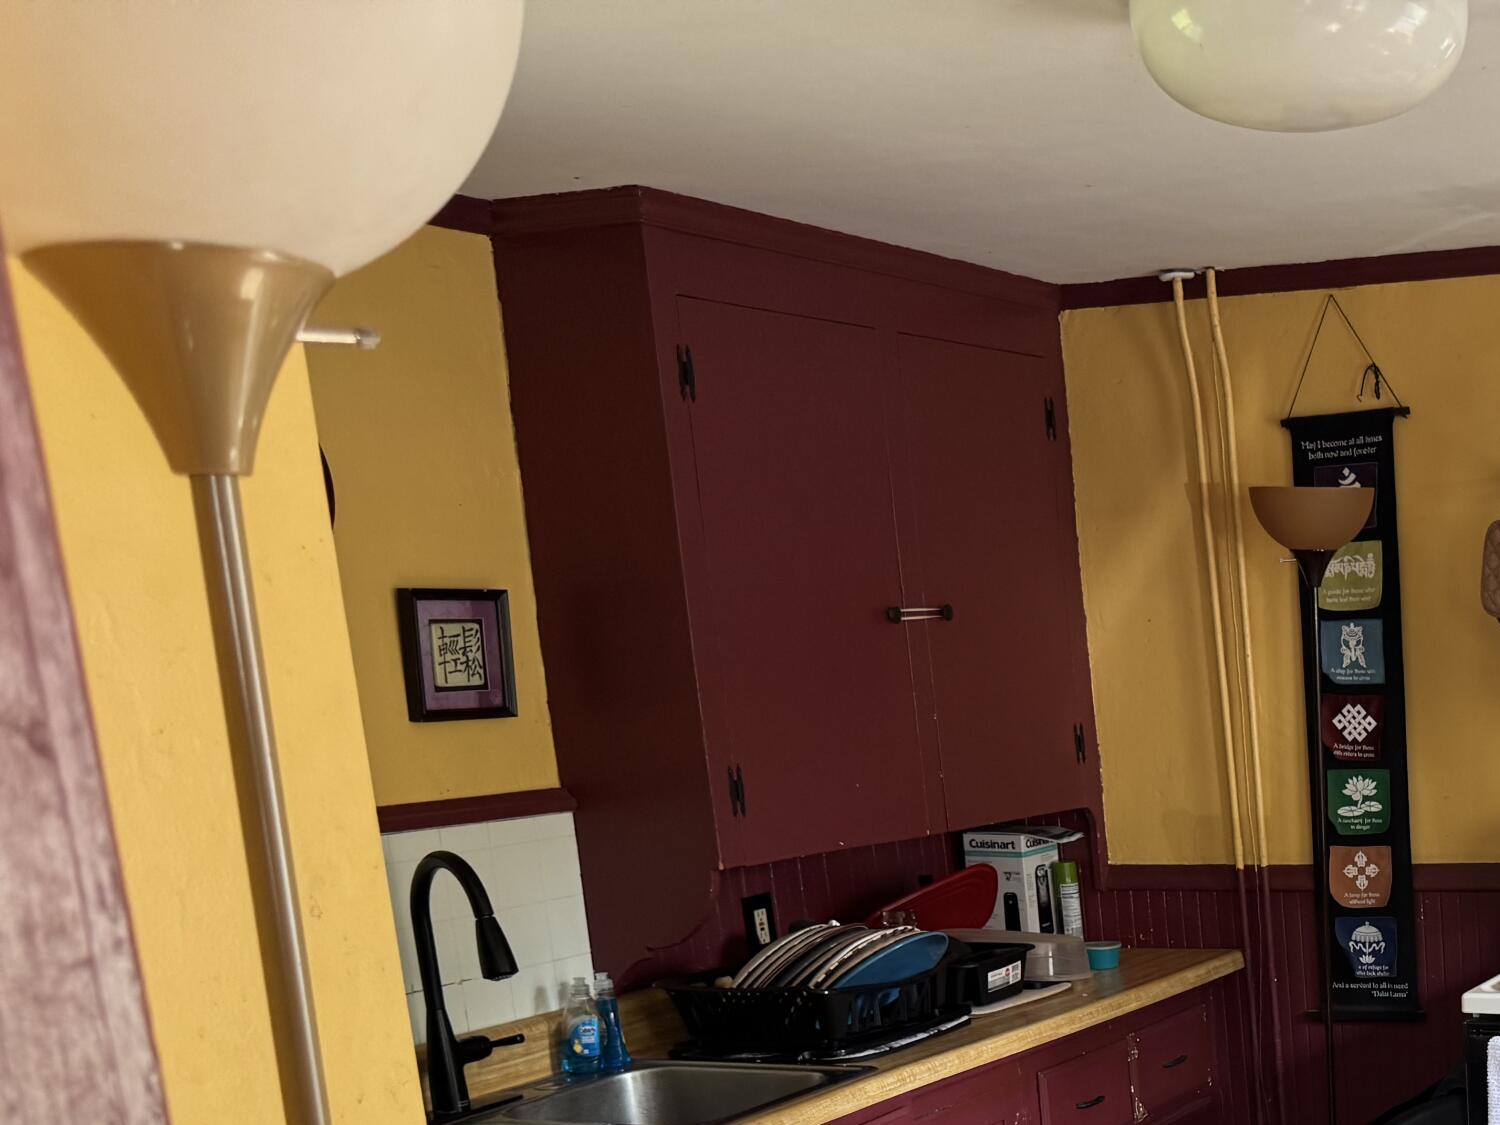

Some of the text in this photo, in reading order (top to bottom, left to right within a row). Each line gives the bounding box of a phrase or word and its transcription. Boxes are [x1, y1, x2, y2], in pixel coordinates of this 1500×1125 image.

[1321, 439, 1348, 448] become
[1308, 451, 1324, 461] both
[1340, 448, 1352, 457] and
[1353, 446, 1377, 457] forever
[969, 839, 1016, 850] Cuisinart
